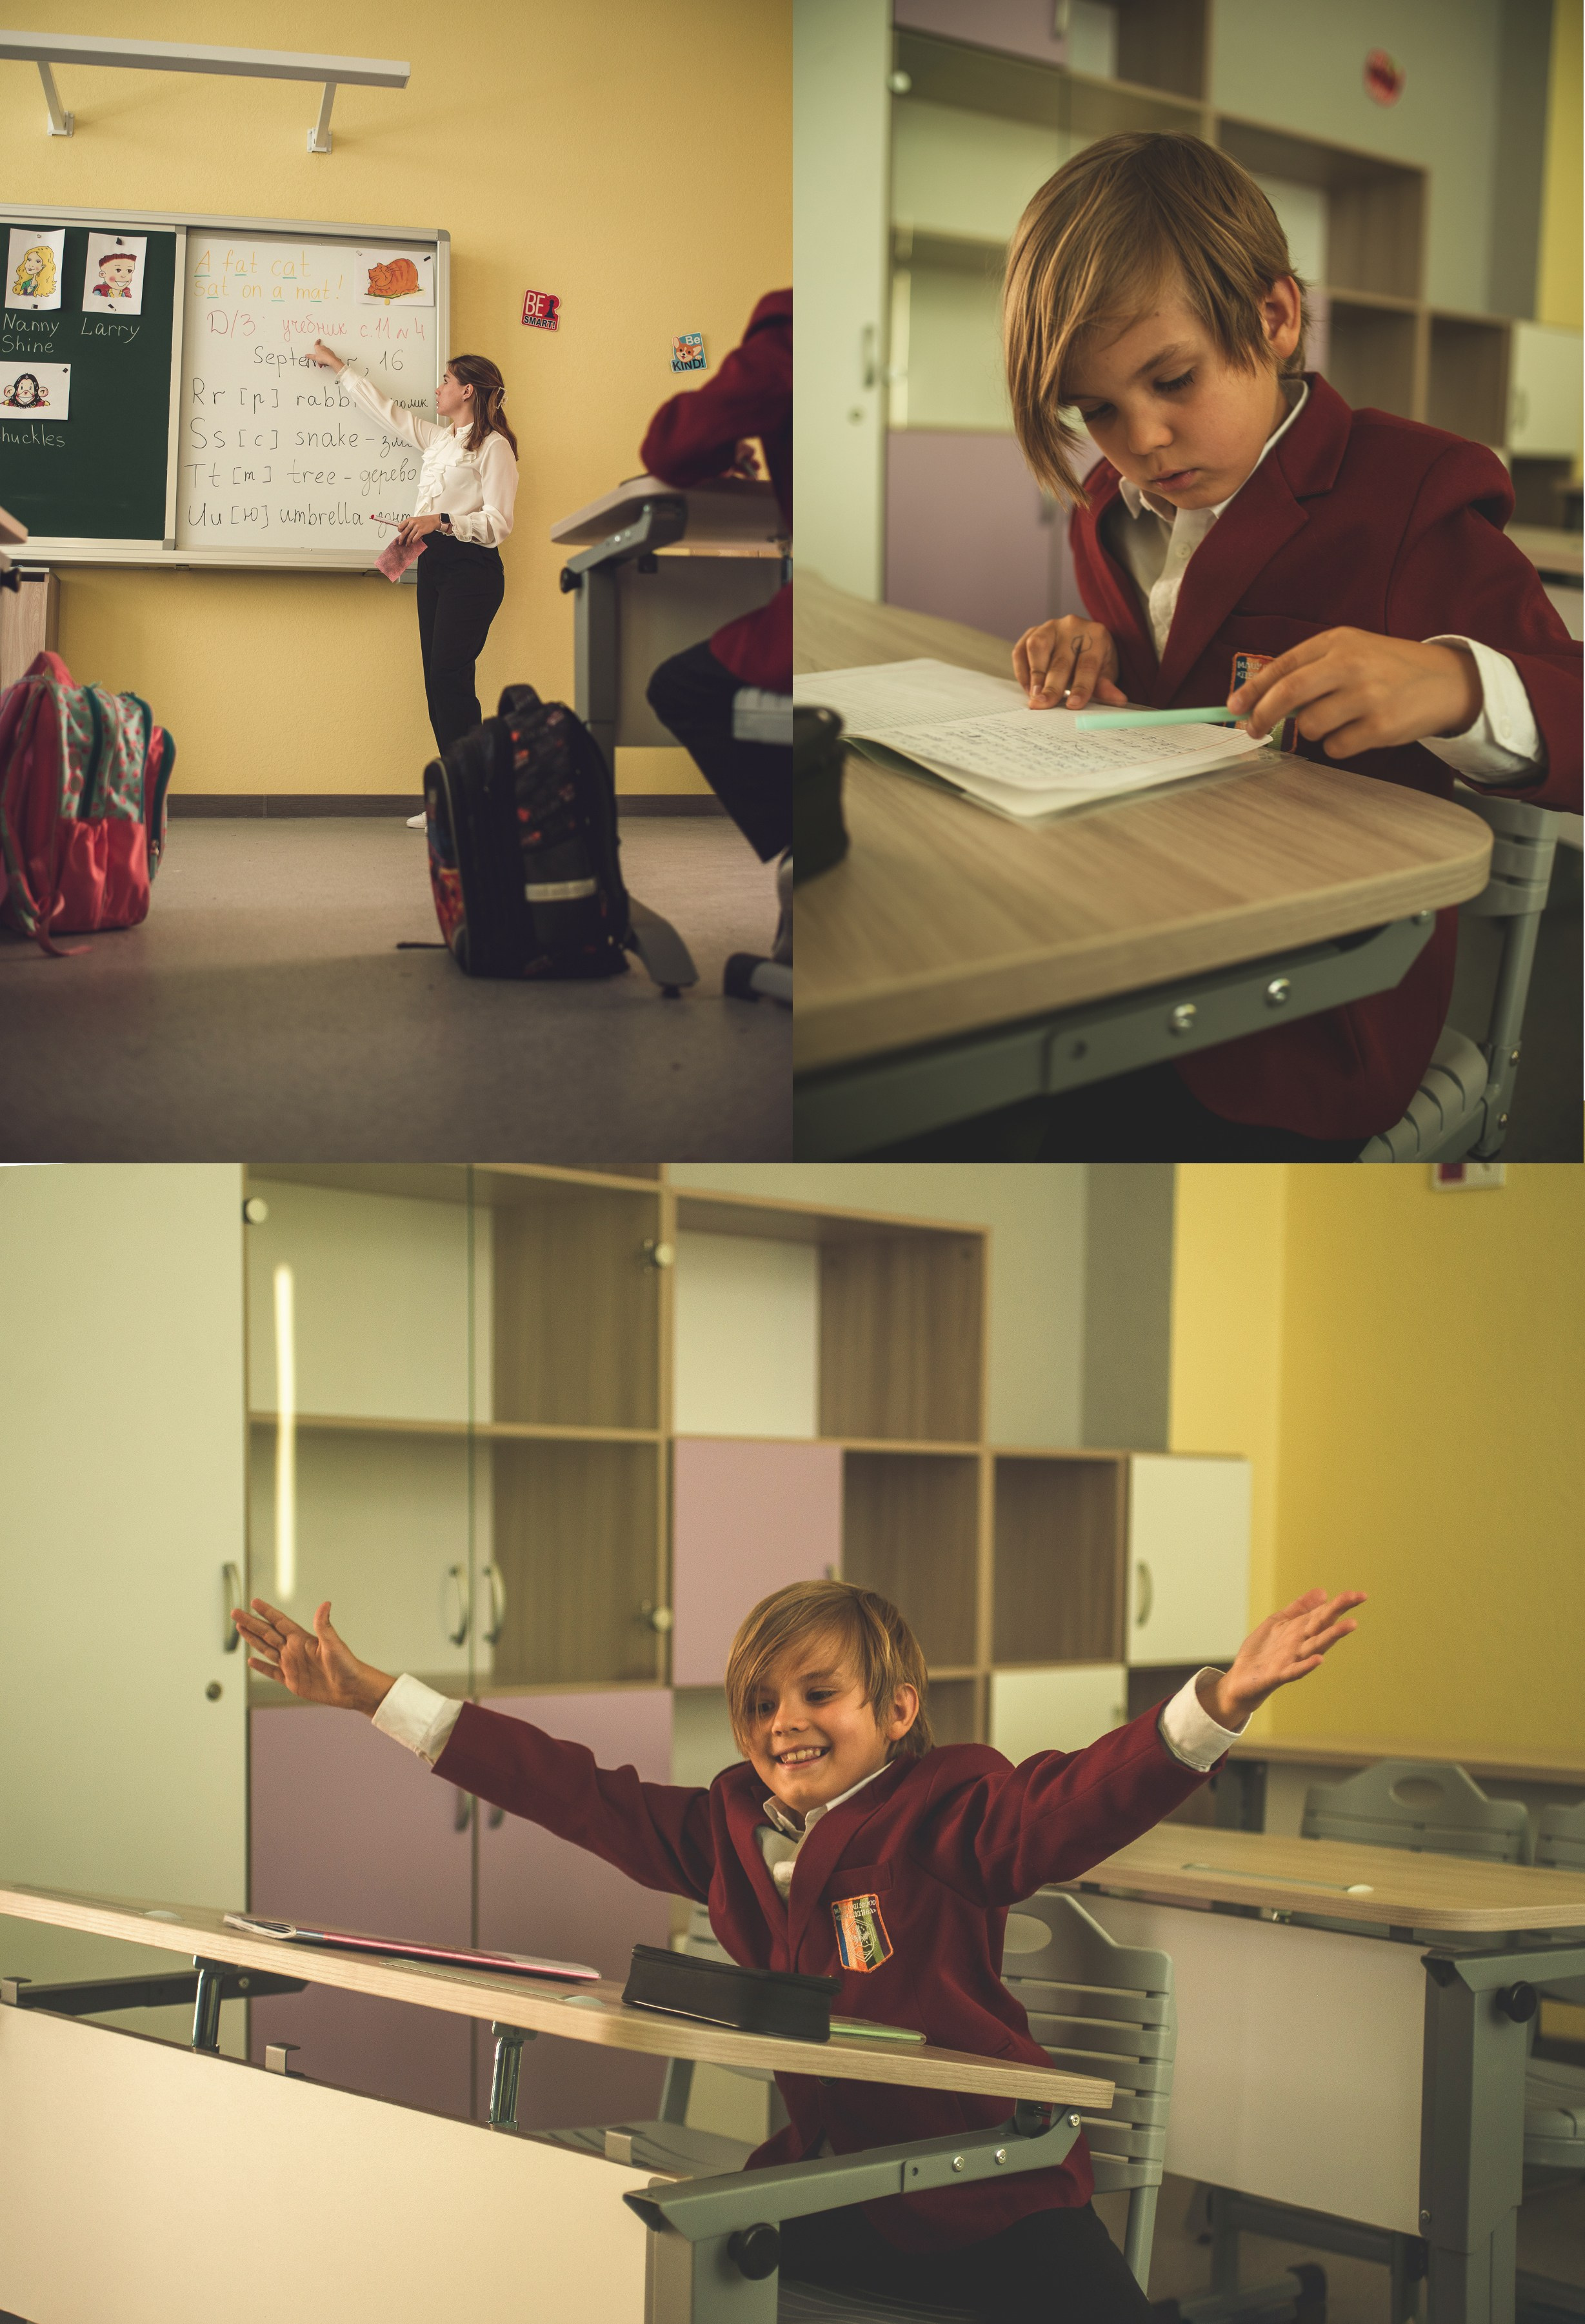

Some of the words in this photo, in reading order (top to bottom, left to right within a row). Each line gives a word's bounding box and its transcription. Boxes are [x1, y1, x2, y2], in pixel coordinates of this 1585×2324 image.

[195, 250, 211, 274] A
[222, 249, 258, 274] fat
[271, 250, 312, 277] cat
[242, 284, 262, 299] on
[272, 285, 283, 299] a
[296, 274, 343, 301] mat!
[524, 292, 546, 317] BE
[3, 312, 60, 337] Nanny
[81, 317, 141, 344] Larry
[283, 314, 348, 343] учебник
[523, 315, 556, 330] SMART!
[1, 334, 54, 353] Shine
[684, 335, 701, 345] Be
[379, 349, 404, 371] 16
[672, 357, 704, 372] KIND!
[193, 377, 226, 405] Rr
[0, 423, 66, 448] huckles
[190, 417, 226, 449] Ss
[295, 423, 359, 448] snake
[184, 461, 221, 488] Tt
[286, 459, 336, 485] tree
[359, 457, 417, 496] дерево
[280, 501, 364, 526] umbrella
